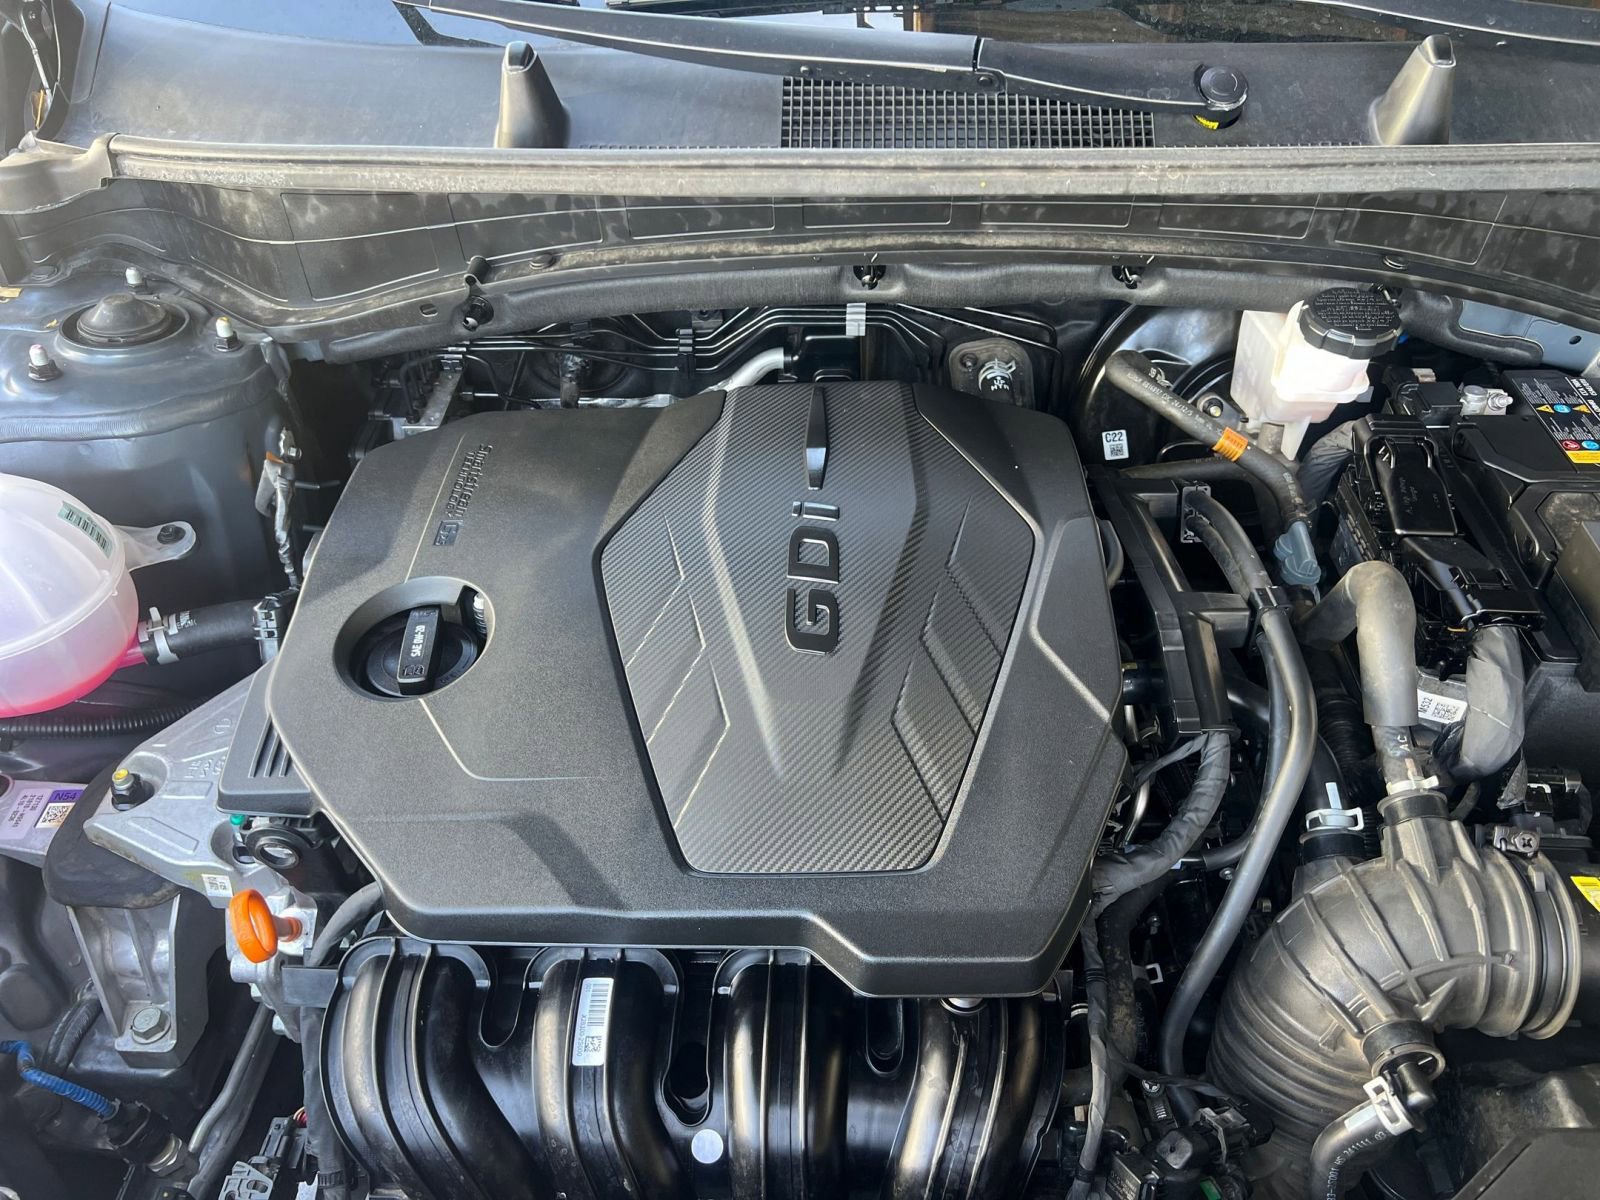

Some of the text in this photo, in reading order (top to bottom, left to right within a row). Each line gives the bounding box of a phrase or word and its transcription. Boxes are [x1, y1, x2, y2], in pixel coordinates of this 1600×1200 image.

[1104, 432, 1123, 442] C22
[445, 452, 475, 517] TECHNOLOGY
[455, 444, 493, 517] Smartstream
[785, 501, 841, 656] GDi
[413, 625, 426, 644] 0W-20
[410, 643, 423, 657] SAE
[54, 792, 77, 801] N54
